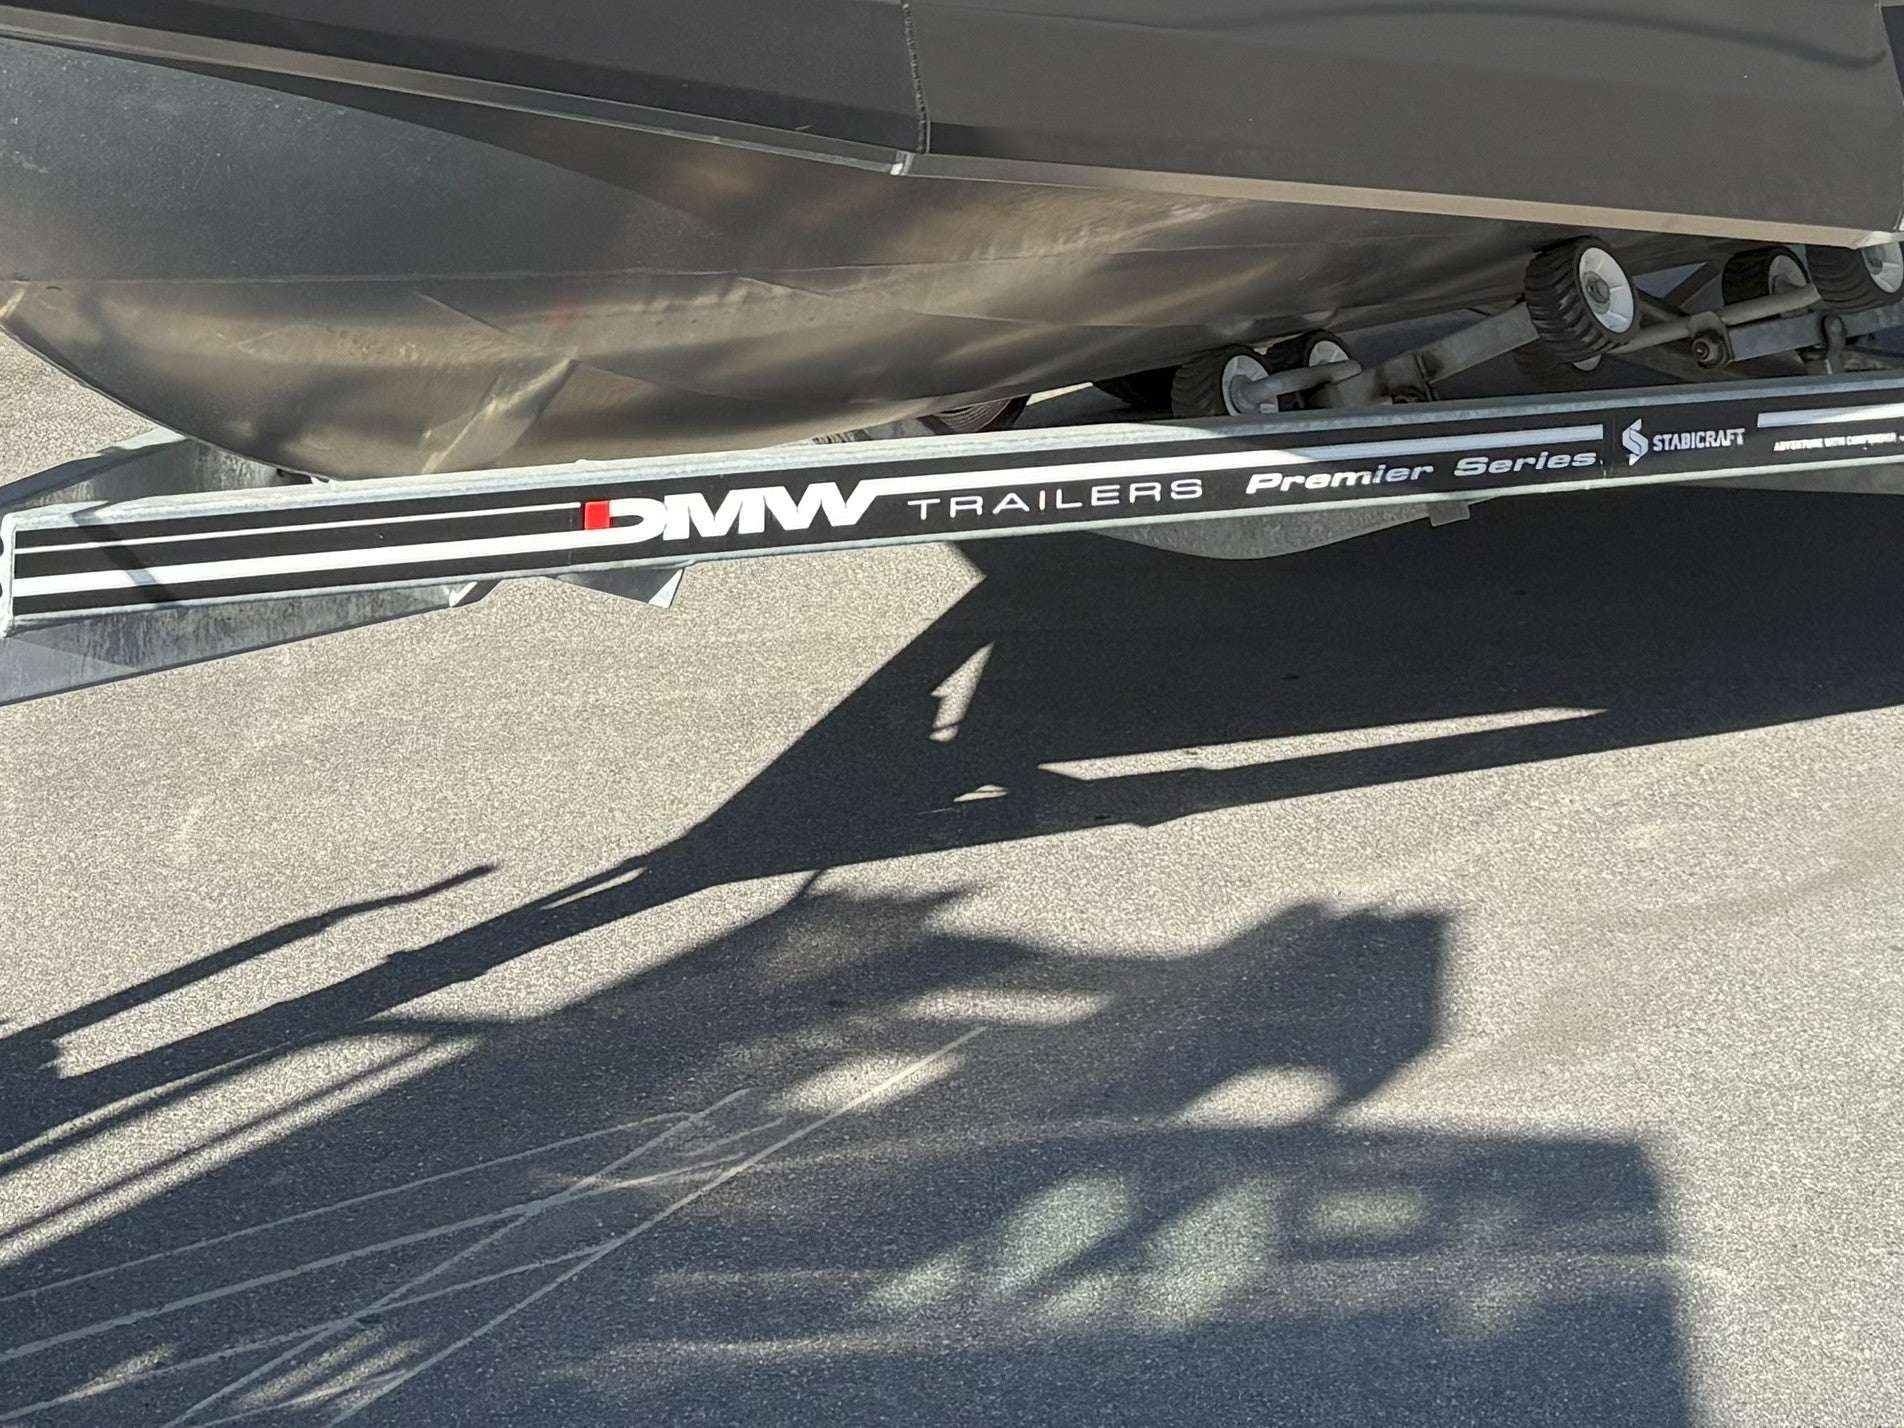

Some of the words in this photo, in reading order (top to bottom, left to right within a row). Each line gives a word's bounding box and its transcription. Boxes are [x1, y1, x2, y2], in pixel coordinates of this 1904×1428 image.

[1653, 428, 1746, 452] STABICRAFT
[584, 480, 879, 546] DMW
[908, 478, 1203, 520] TRAILERS
[1245, 460, 1432, 496] Premier
[1453, 450, 1597, 477] Series
